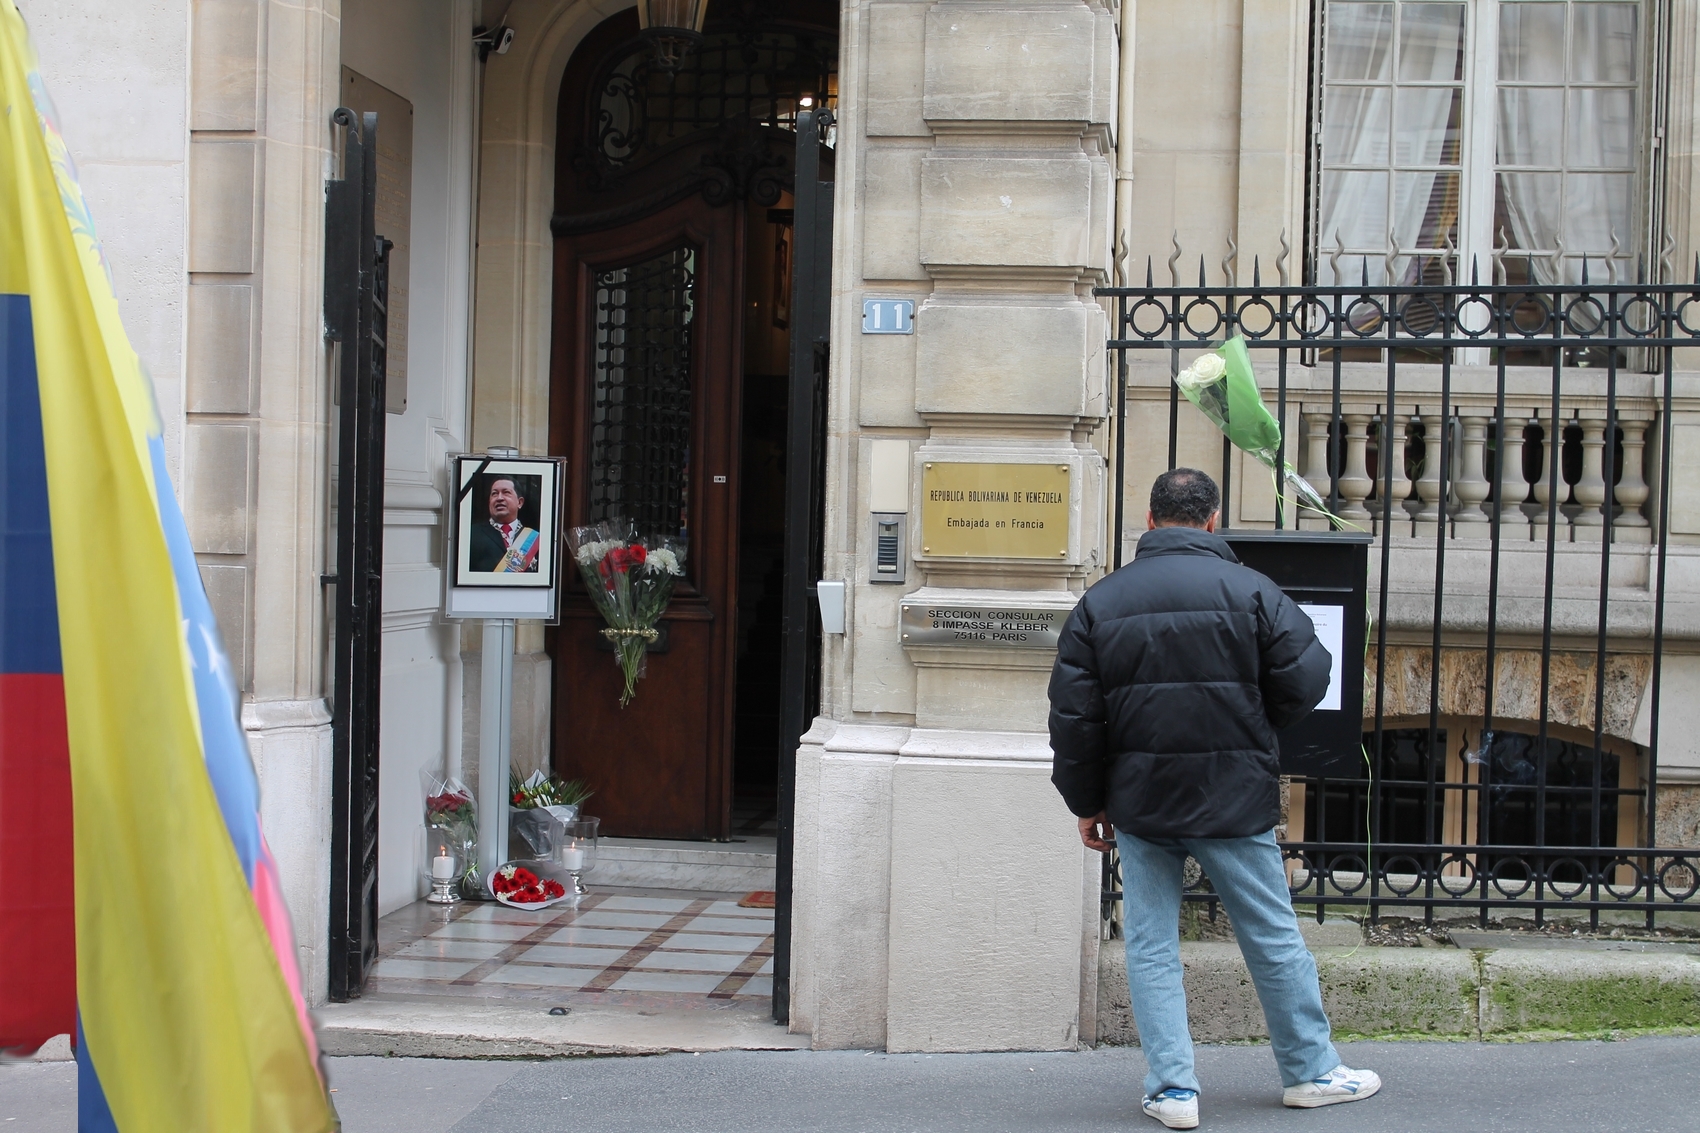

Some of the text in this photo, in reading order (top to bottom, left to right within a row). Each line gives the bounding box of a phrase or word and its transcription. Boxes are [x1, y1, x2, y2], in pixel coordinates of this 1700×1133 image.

[872, 303, 903, 329] 11
[930, 490, 1063, 504] REPUBLICA BOLIVARIANA DE VENEZUELA
[947, 517, 1044, 530] Embajada en Francia
[928, 610, 1054, 621] SECCION CONSULAR
[932, 620, 939, 628] 8
[942, 621, 994, 630] IMPASSE
[954, 631, 1027, 641] 75116 PARIS
